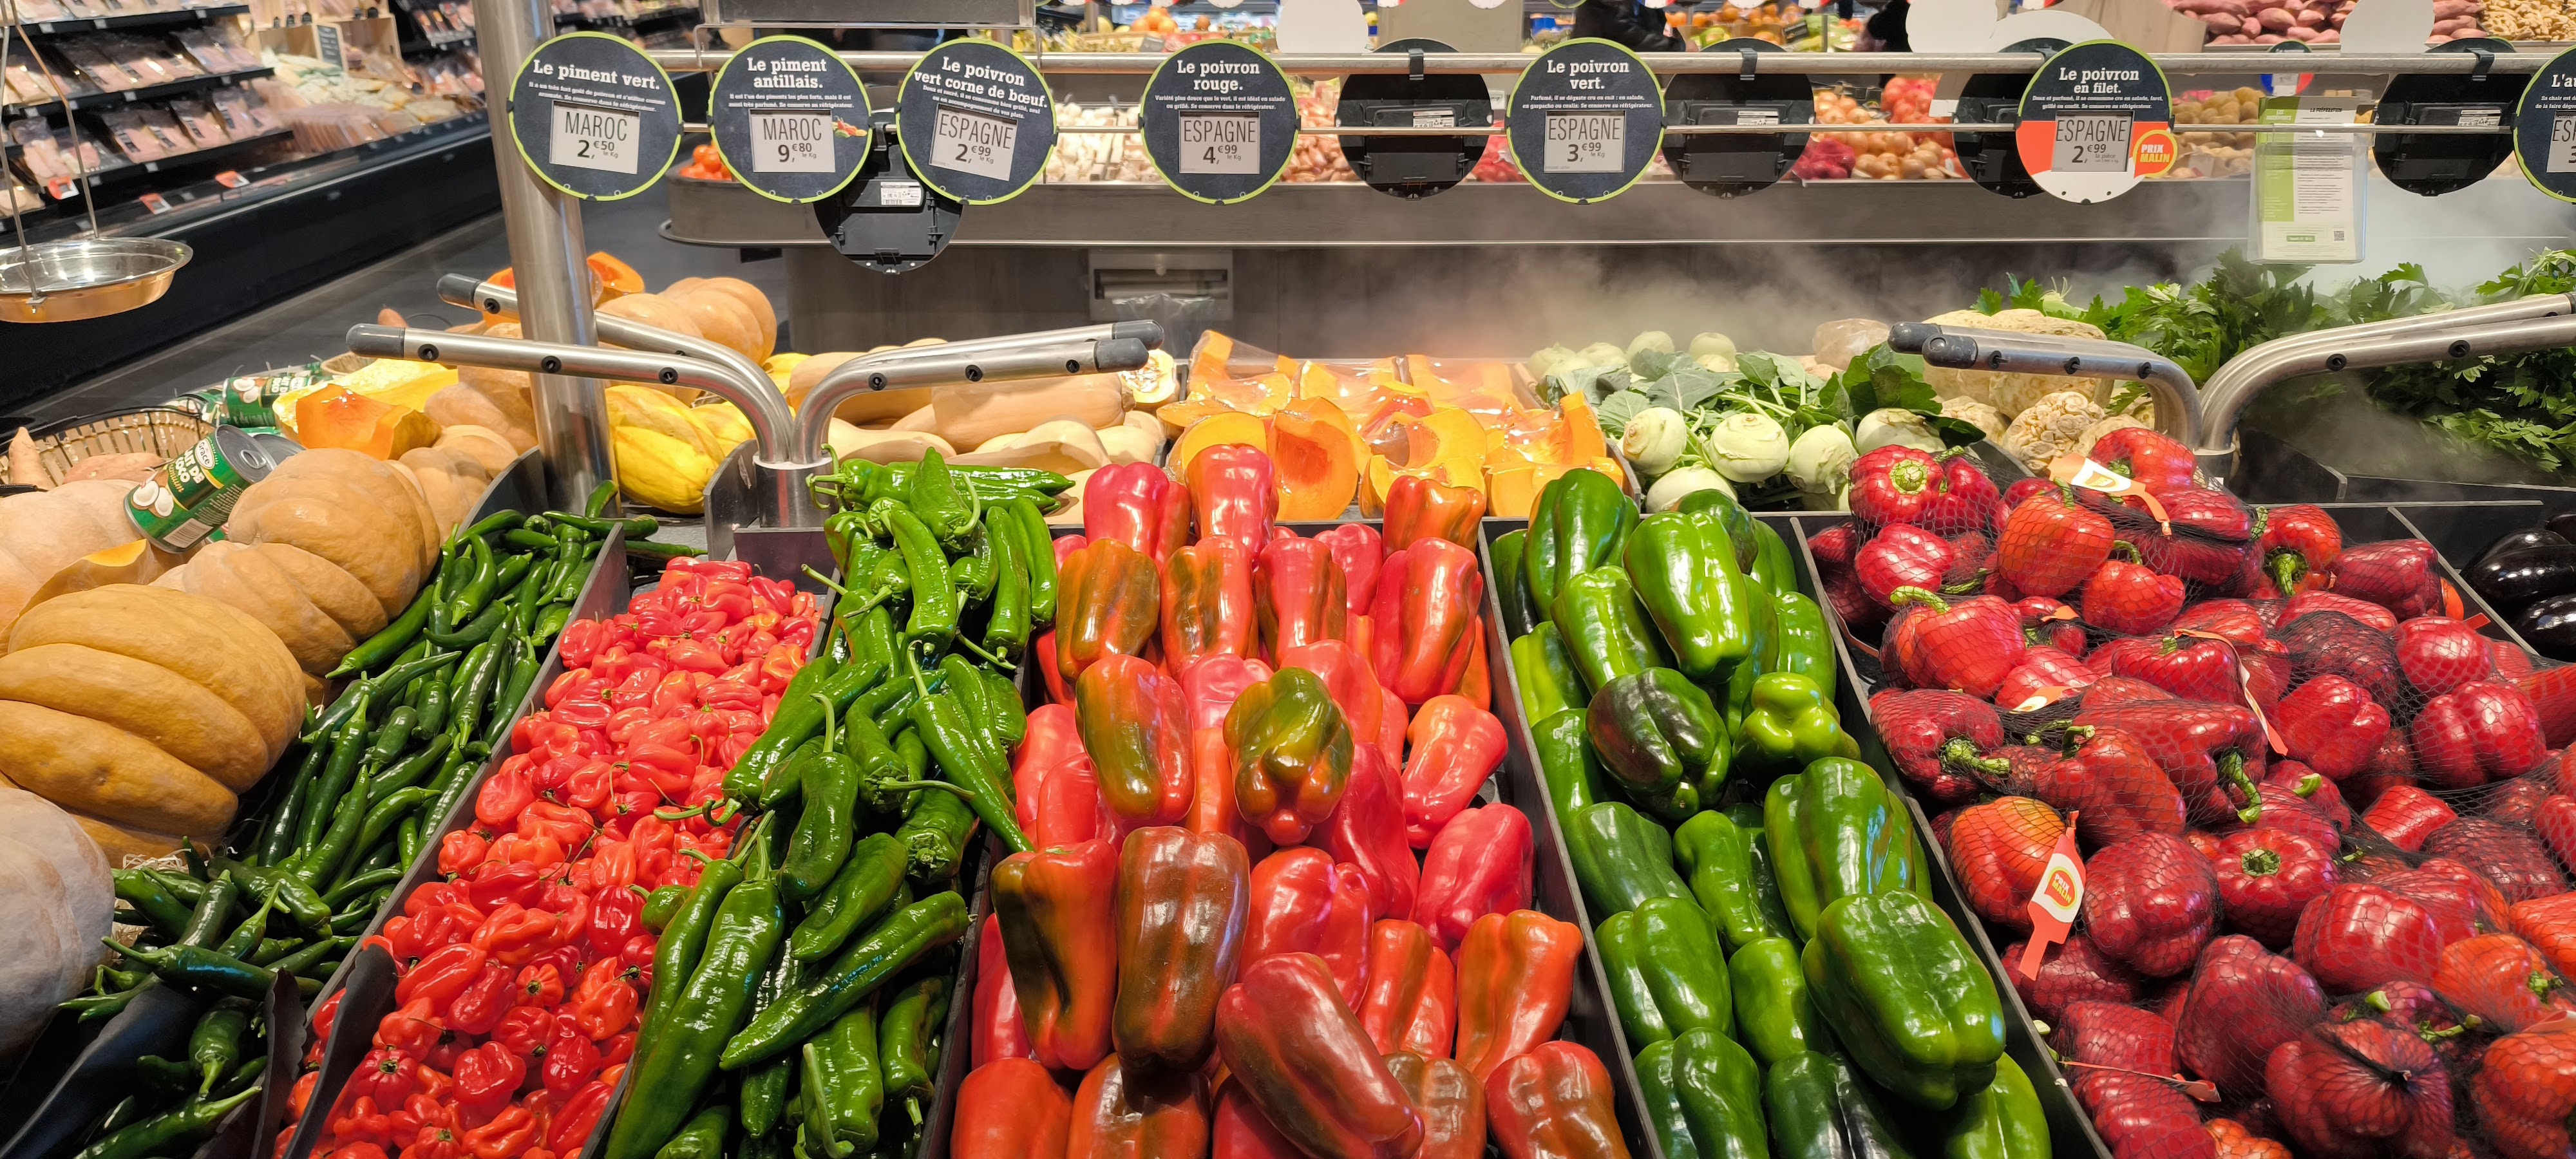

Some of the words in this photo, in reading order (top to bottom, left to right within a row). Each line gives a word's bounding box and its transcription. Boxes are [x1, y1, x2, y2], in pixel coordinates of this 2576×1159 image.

[533, 59, 554, 75] Le
[558, 64, 618, 84] piment
[622, 73, 660, 90] vert.
[747, 57, 766, 71] Le
[770, 57, 827, 74] piment
[942, 56, 961, 73] Le
[964, 64, 1025, 87] poivron
[1177, 60, 1195, 73] Le
[1200, 60, 1260, 77] poivron
[1547, 60, 1566, 73] Le
[1569, 60, 1629, 76] poivron
[2059, 67, 2078, 80] Le
[2081, 68, 2139, 84] poivron
[753, 75, 823, 88] antillais.
[914, 71, 942, 85] vert
[945, 78, 984, 95] corne
[988, 85, 1005, 99] de
[1008, 89, 1048, 108] bœuf.
[1193, 79, 1243, 93] rouge.
[1569, 77, 1605, 90] vert.
[2074, 84, 2089, 93] en
[2092, 82, 2121, 93] filet.
[2551, 73, 2576, 88] L'a
[565, 111, 628, 141] MAROC
[762, 118, 822, 141] MAROC
[939, 113, 1014, 149] ESPAGNE
[1184, 120, 1256, 142] ESPAGNE
[1548, 118, 1621, 140] ESPAGNE
[2056, 119, 2127, 142] ESPAGNE
[2140, 153, 2170, 162] MALIN
[2141, 144, 2164, 153] PRIX
[184, 446, 196, 467] AIT
[199, 442, 210, 465] Grace
[175, 457, 191, 483] COCO
[189, 465, 205, 484] DE
[2052, 880, 2072, 903] MALIN
[2054, 873, 2070, 890] PRIX
